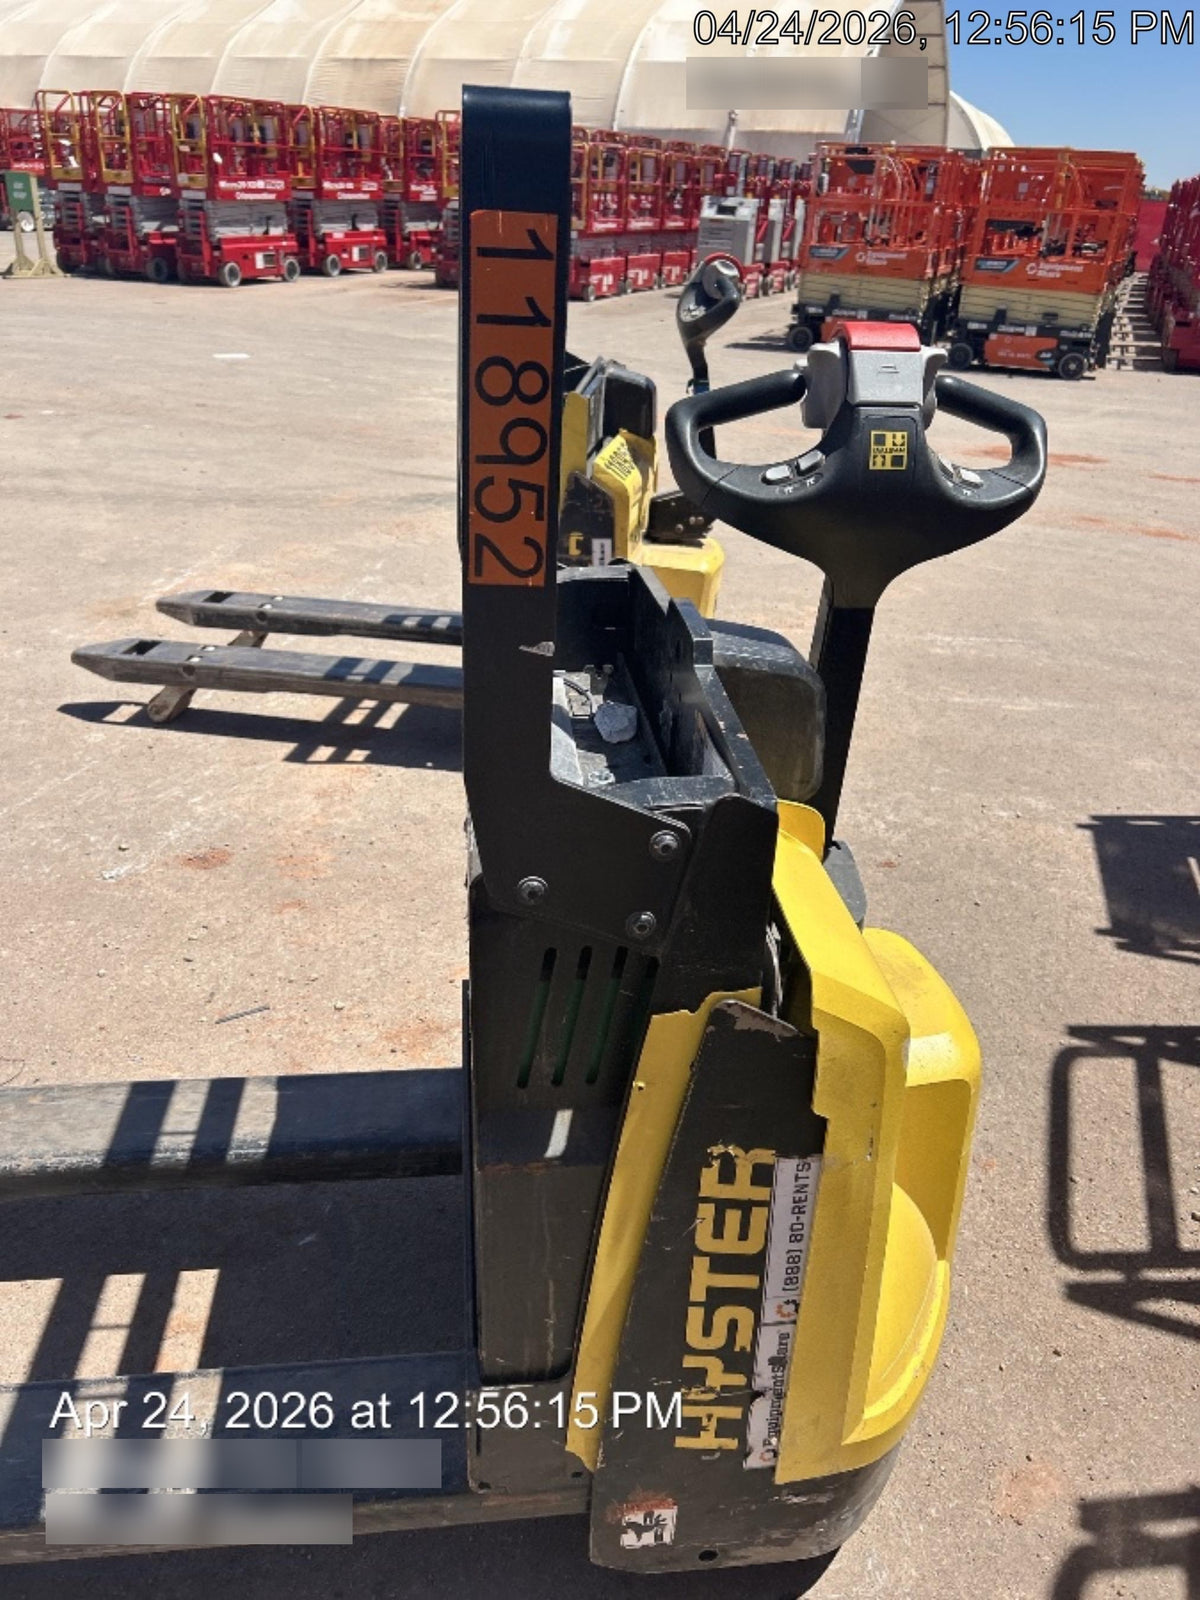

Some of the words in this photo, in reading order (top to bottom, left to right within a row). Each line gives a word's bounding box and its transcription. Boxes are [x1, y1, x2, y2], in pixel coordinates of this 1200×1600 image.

[473, 228, 555, 579] 118952
[788, 1160, 812, 1245] 80-RENTS
[674, 1141, 776, 1451] HYSTER
[782, 1249, 803, 1293] (888)
[762, 1331, 790, 1448] EquipmentSare
